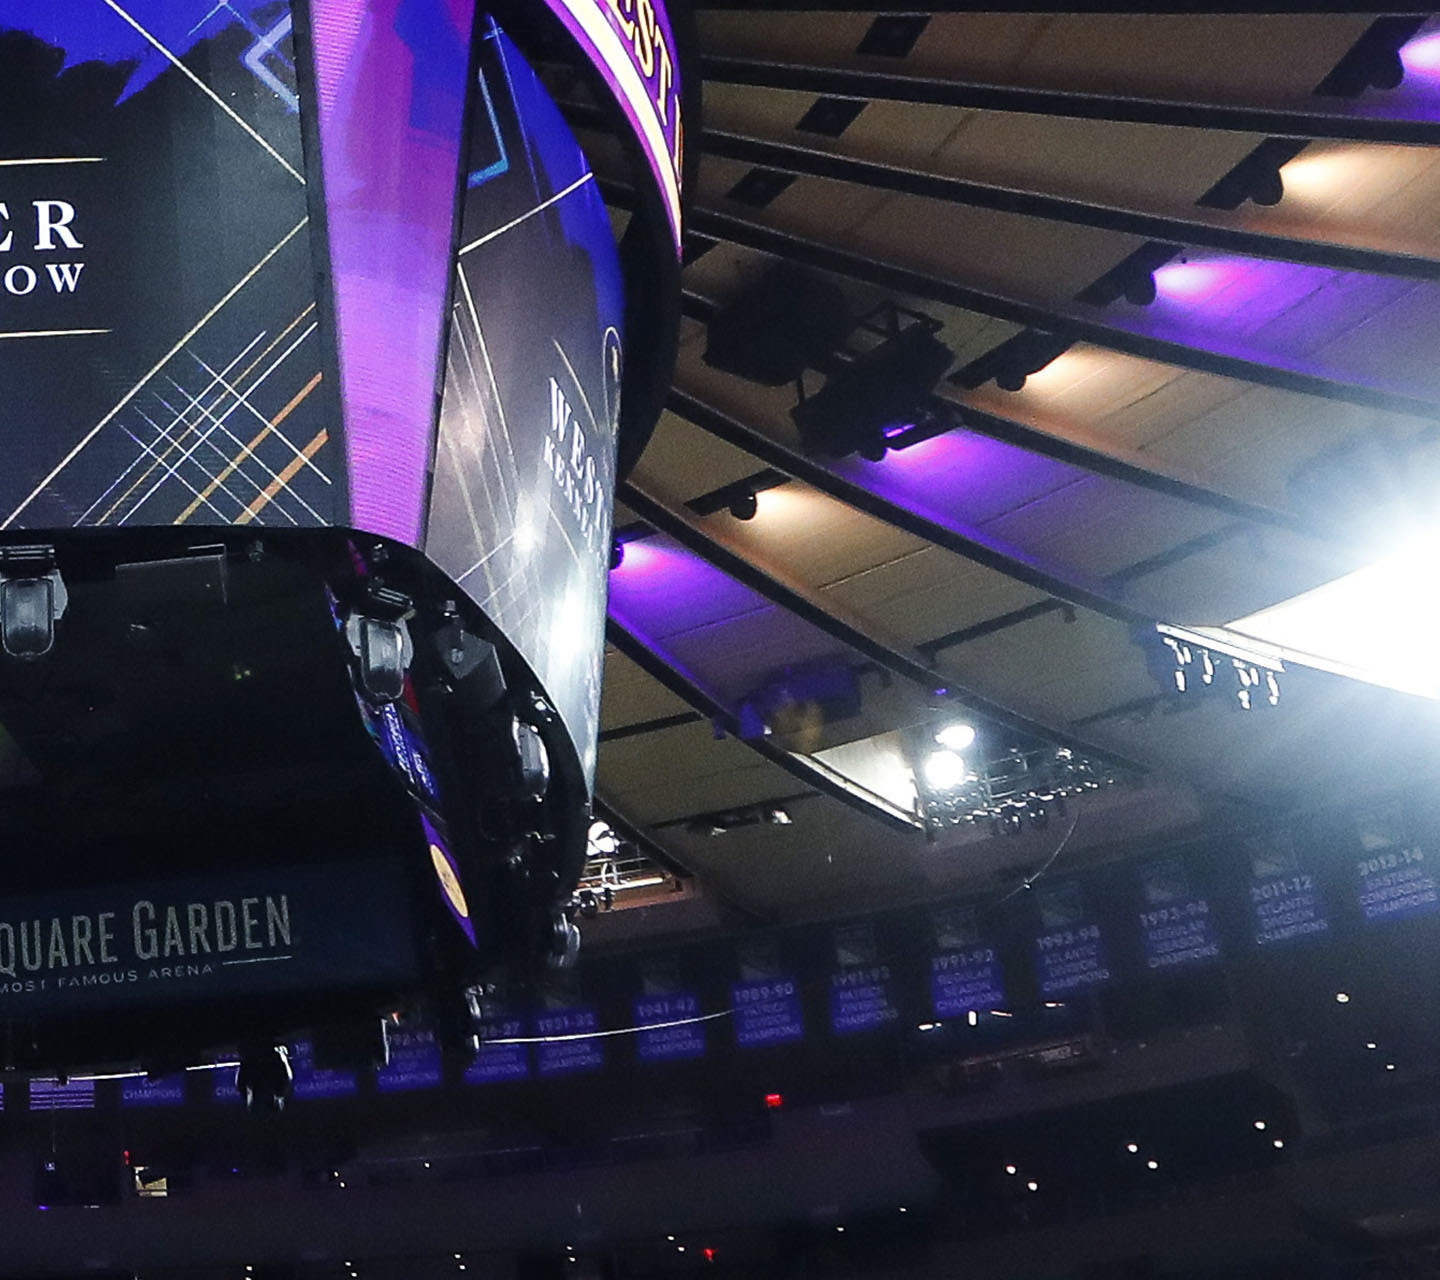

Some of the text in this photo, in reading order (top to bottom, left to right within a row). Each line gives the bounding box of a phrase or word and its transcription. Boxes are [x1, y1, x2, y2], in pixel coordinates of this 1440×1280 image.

[1249, 875, 1313, 902] 2011-12
[131, 893, 293, 961] GARDEN
[57, 970, 139, 990] FAMOUS
[147, 963, 214, 980] ARENA
[733, 982, 795, 1004] 1989-90
[122, 1087, 183, 1100] CHAMPIONS
[293, 1079, 355, 1093] CHAMPIONS
